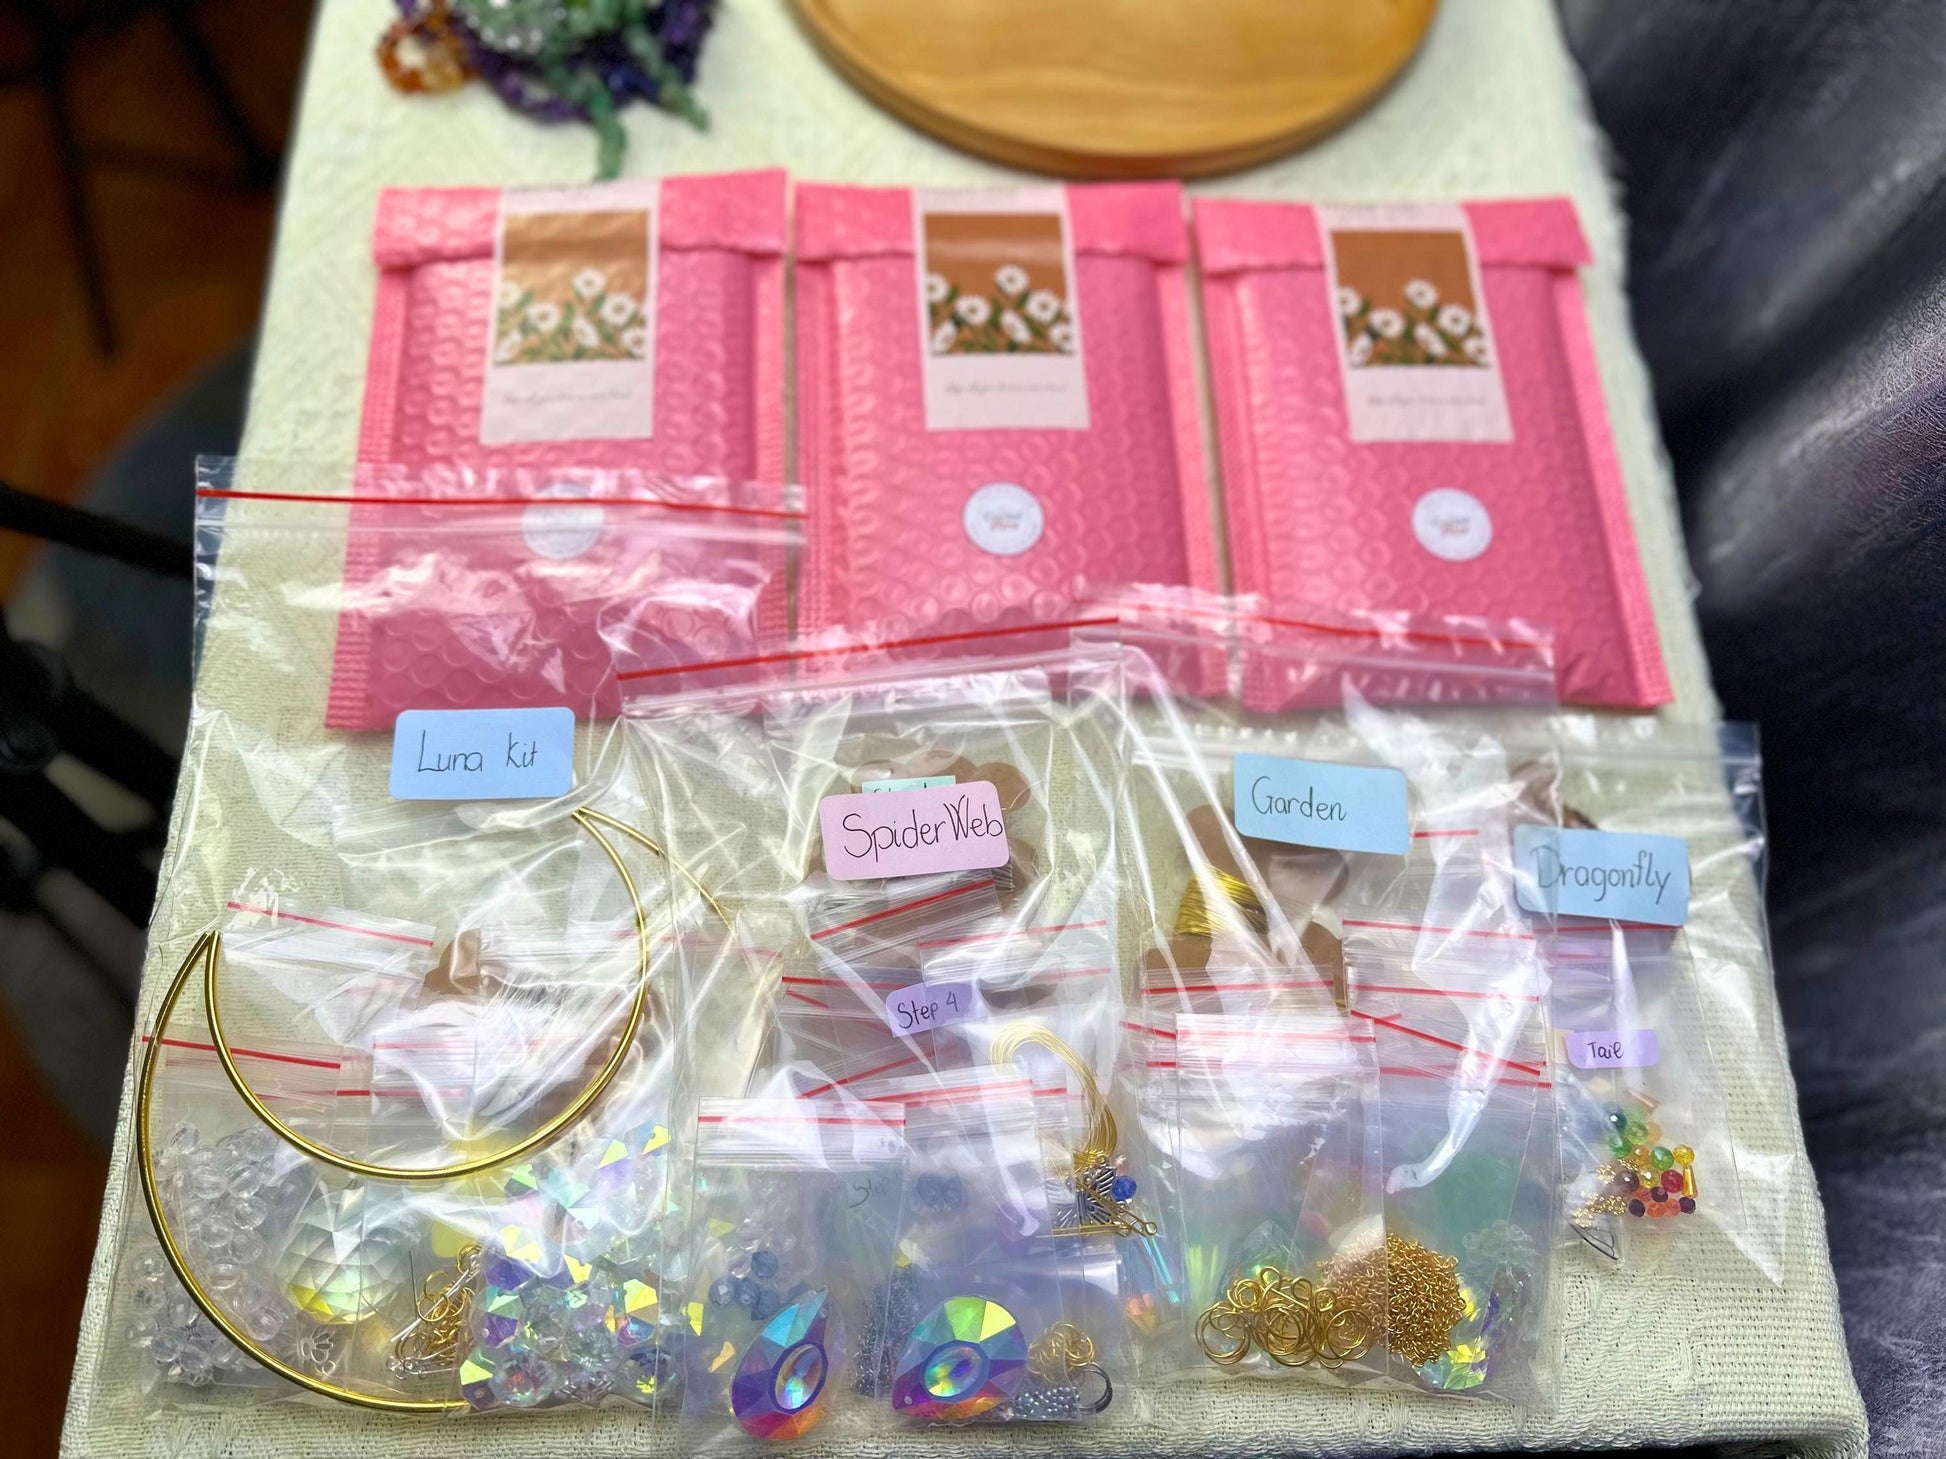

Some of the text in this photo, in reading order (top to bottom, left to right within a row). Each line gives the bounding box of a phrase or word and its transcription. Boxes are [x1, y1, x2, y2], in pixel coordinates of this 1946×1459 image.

[417, 729, 483, 772] Luna
[1251, 775, 1347, 822] Garden
[1529, 844, 1672, 905] Dragonfly
[897, 991, 959, 1029] Step 4
[1587, 1041, 1625, 1060] Tail
